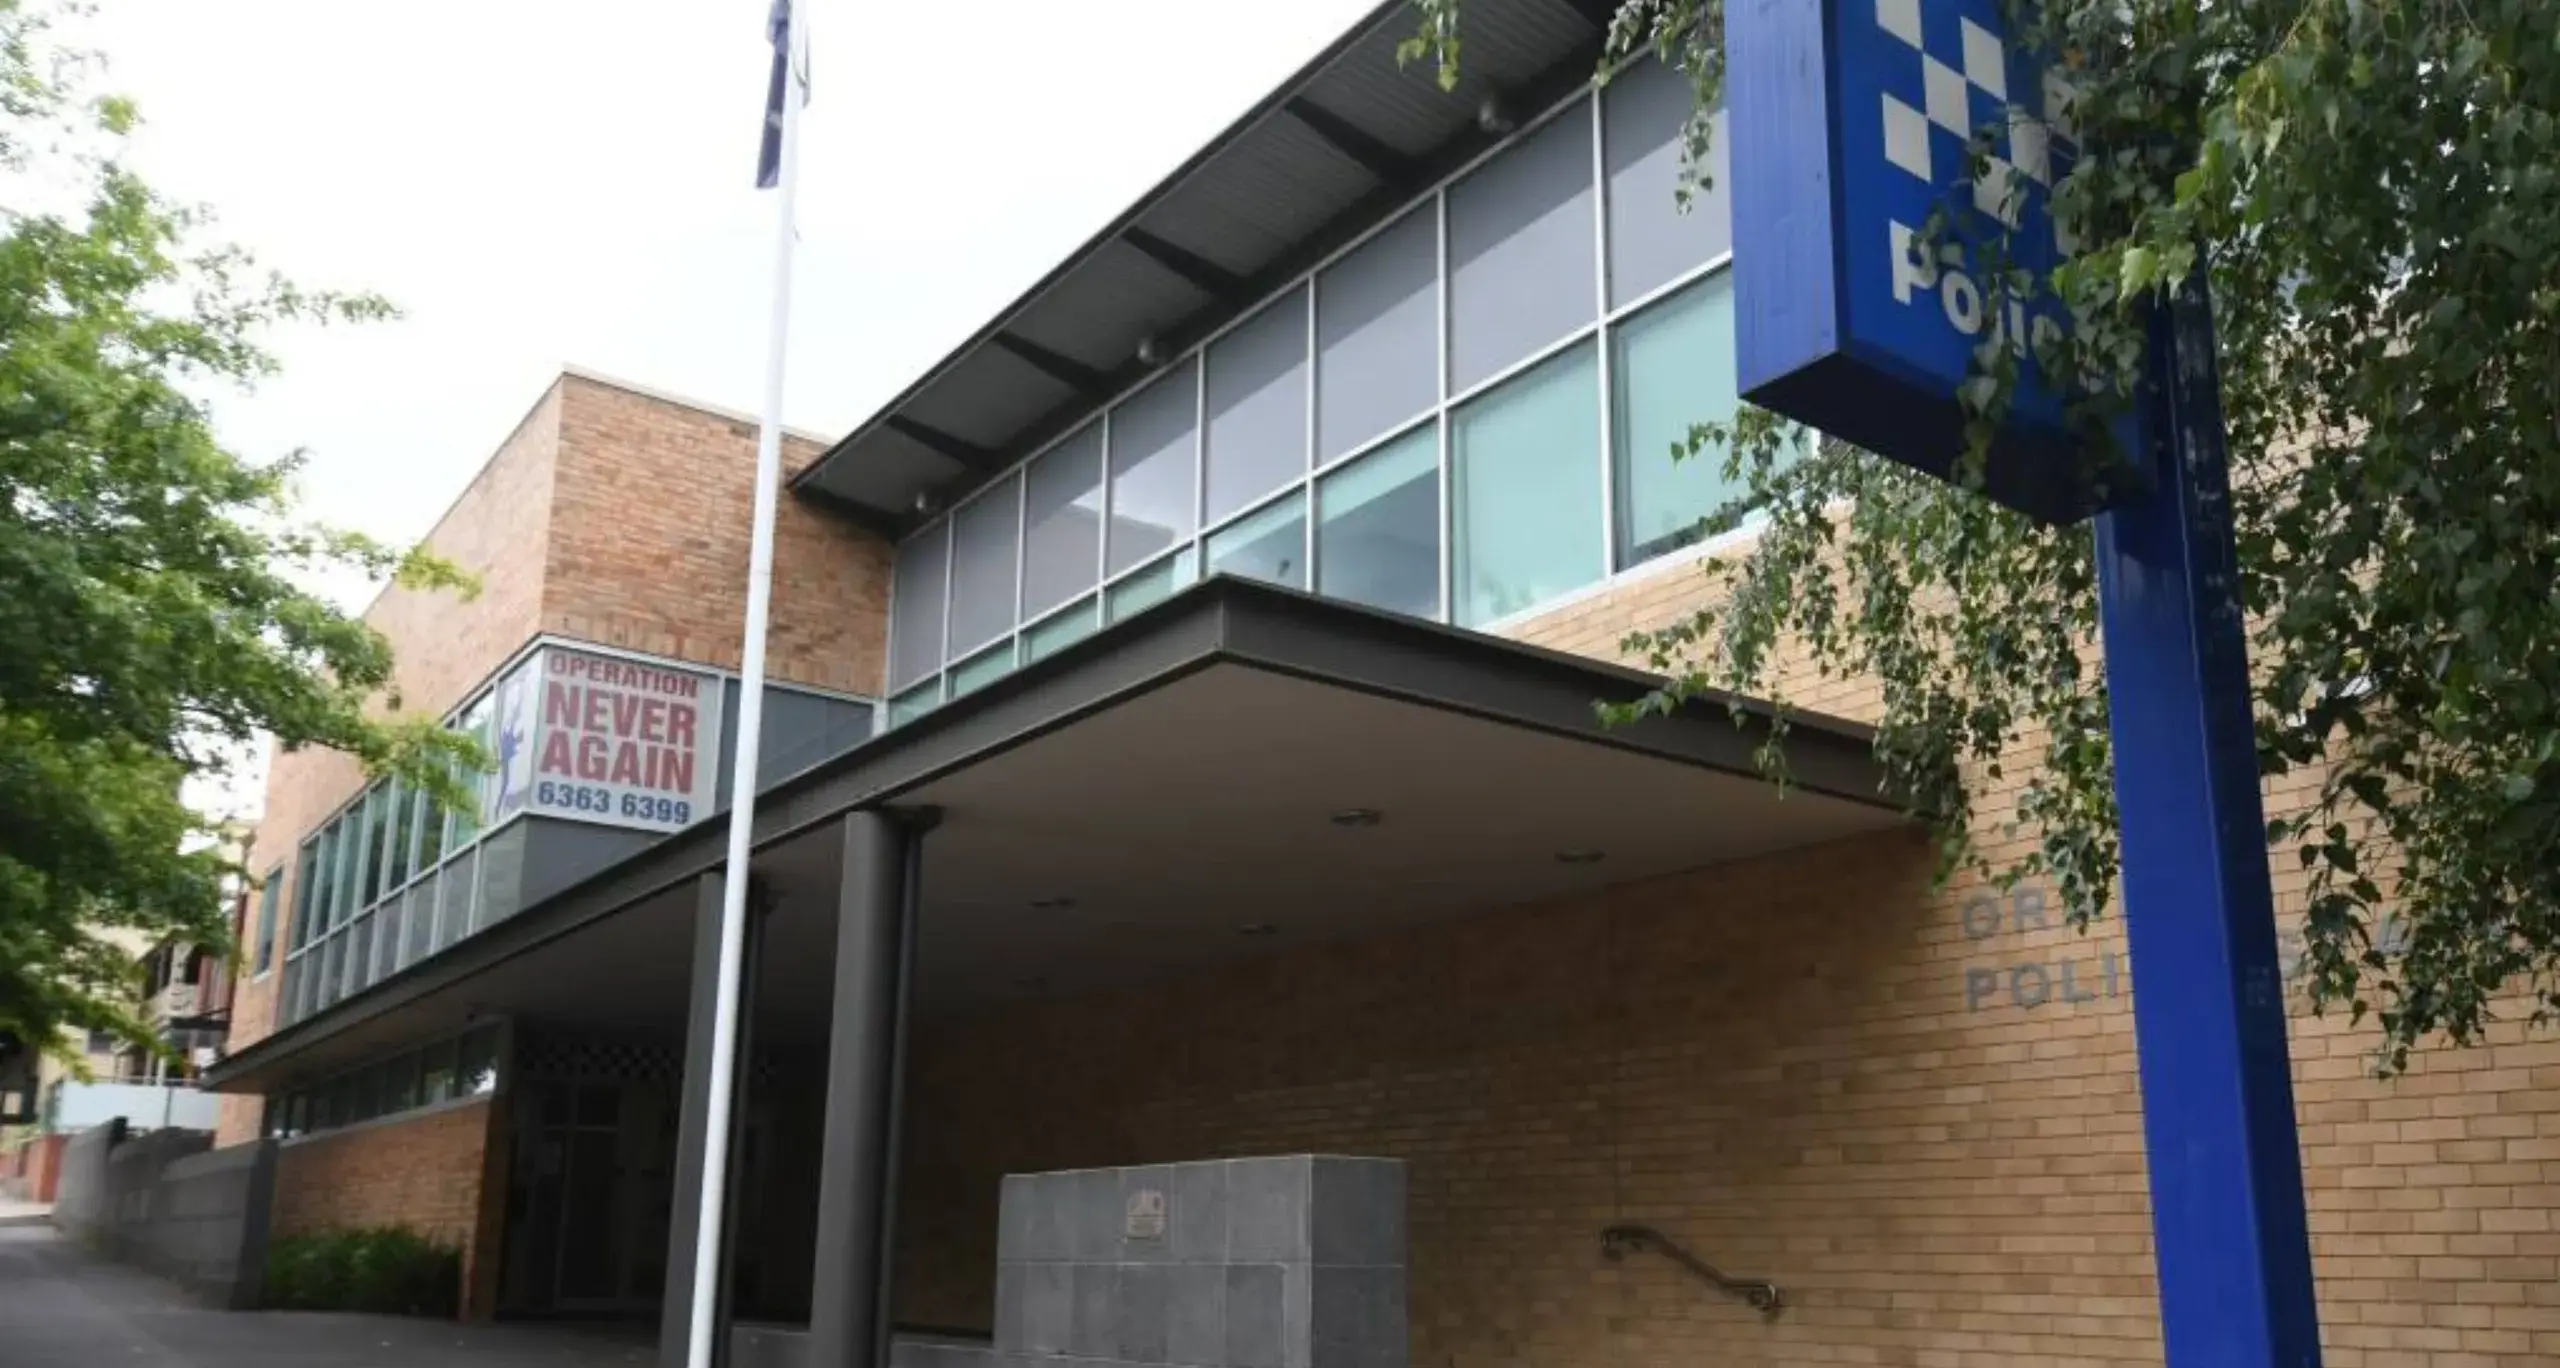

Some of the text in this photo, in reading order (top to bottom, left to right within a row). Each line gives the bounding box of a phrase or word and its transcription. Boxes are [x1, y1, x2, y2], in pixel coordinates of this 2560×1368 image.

[1889, 217, 2064, 360] Polic
[550, 653, 698, 698] OPERATION
[545, 681, 698, 748] NEVER
[540, 730, 694, 796] AGAIN
[537, 781, 692, 825] 6363 6399
[1964, 953, 2118, 1015] POLI
